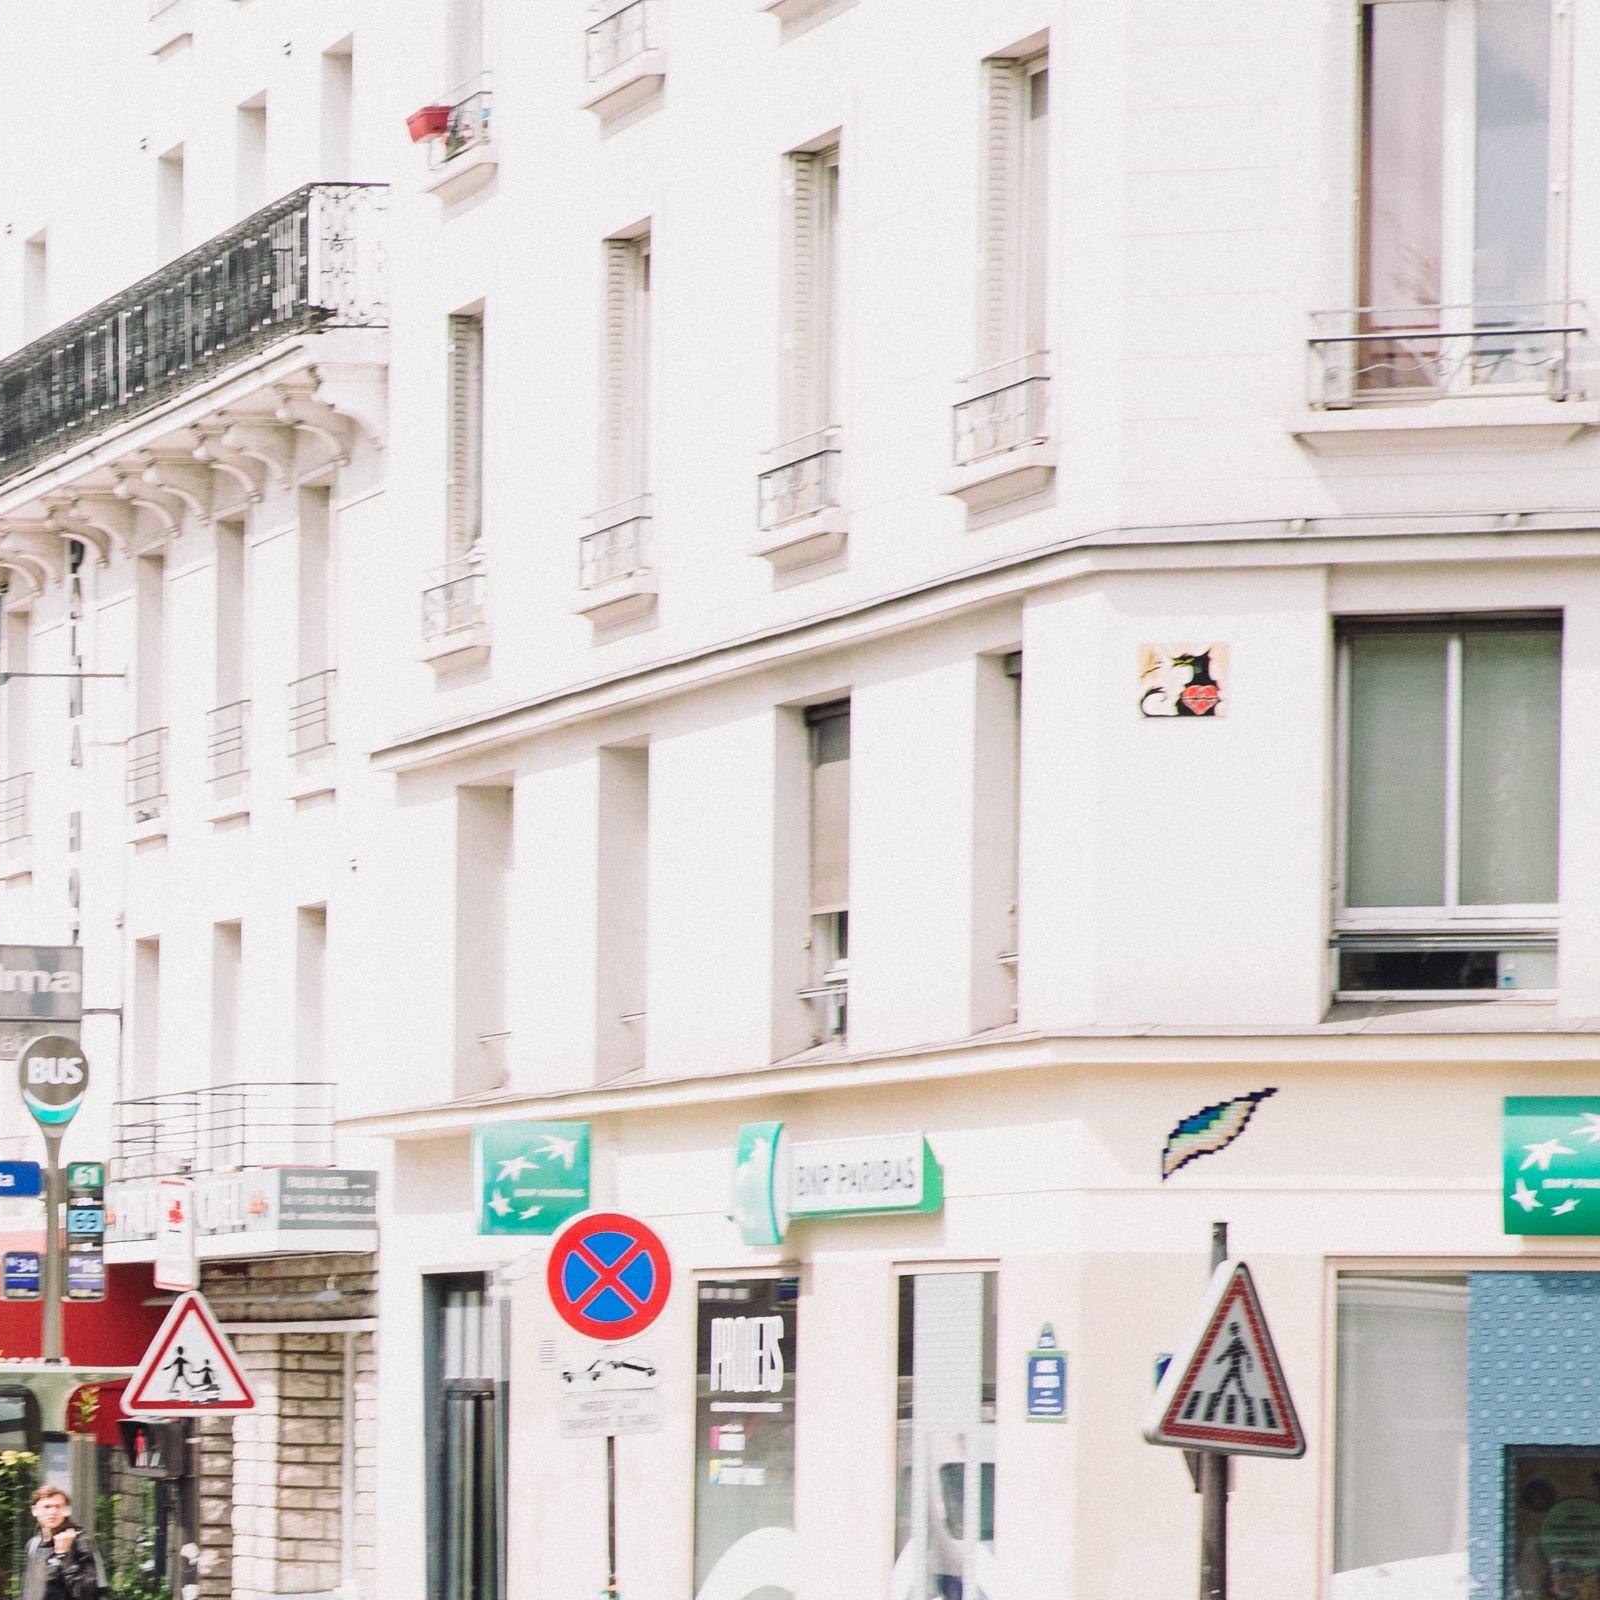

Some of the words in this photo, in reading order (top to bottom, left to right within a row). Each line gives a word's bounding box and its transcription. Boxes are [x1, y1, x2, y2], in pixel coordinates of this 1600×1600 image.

[27, 1057, 84, 1085] BUS
[73, 1166, 100, 1186] 61
[75, 1212, 98, 1231] 69
